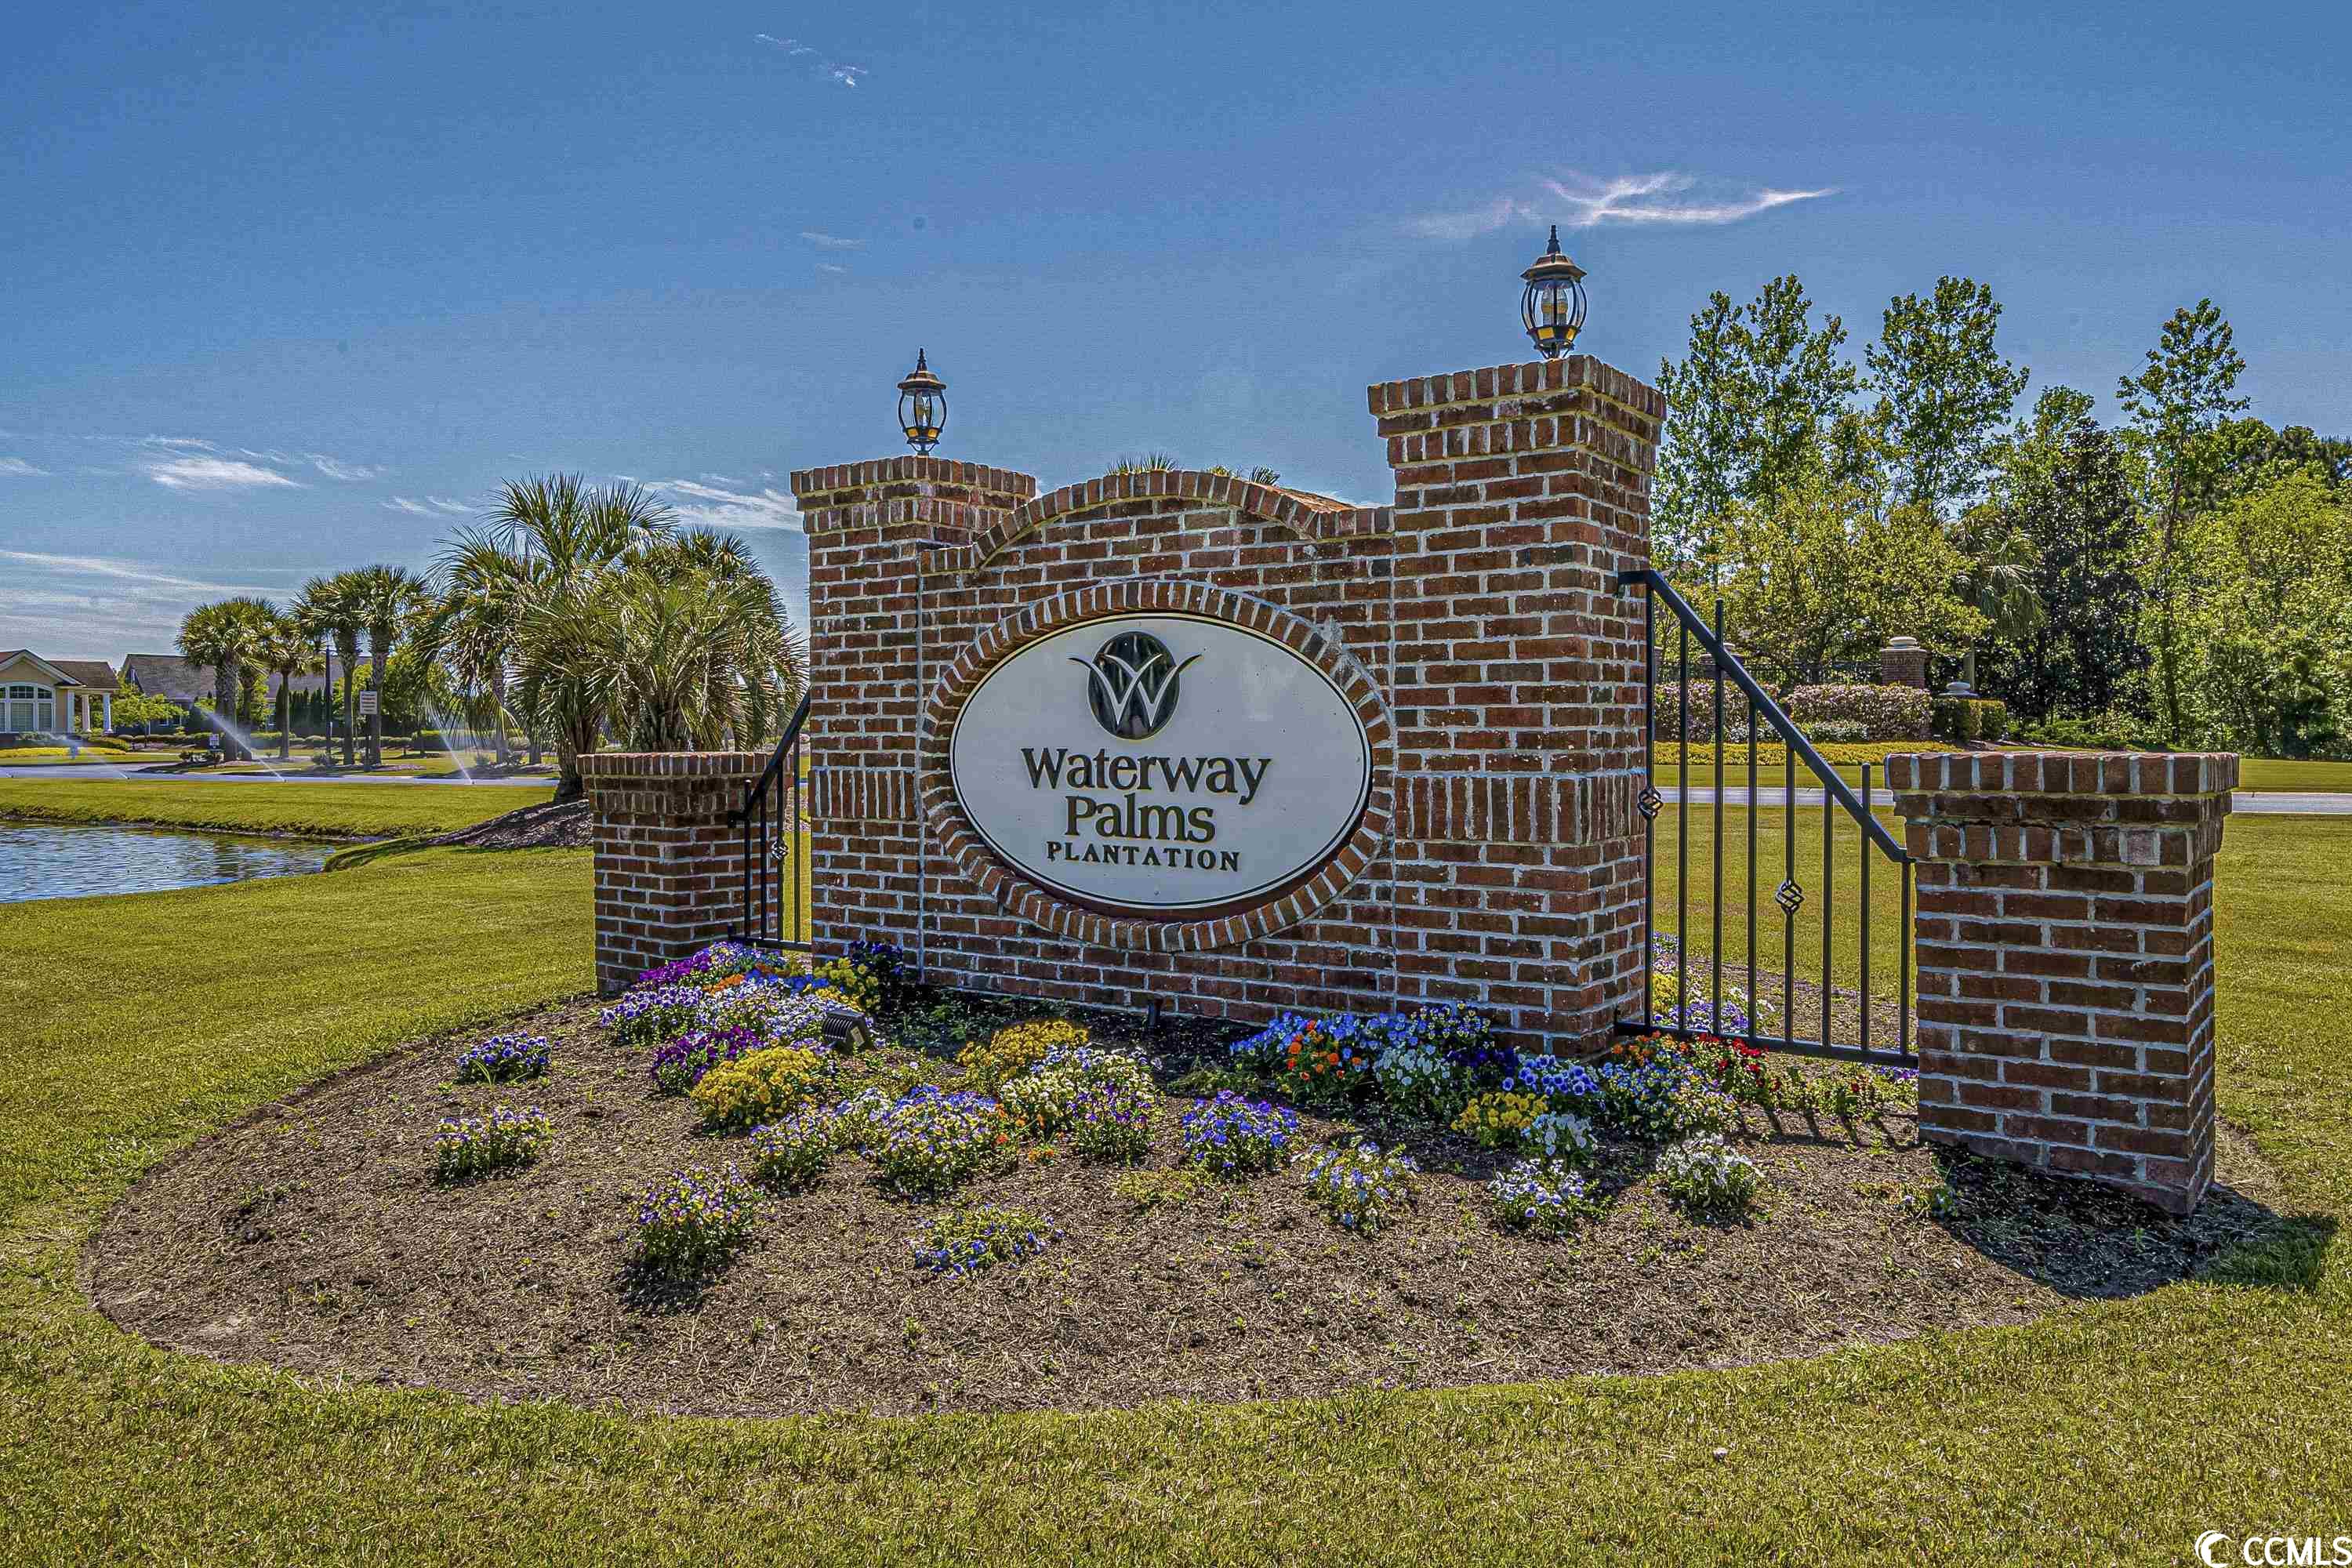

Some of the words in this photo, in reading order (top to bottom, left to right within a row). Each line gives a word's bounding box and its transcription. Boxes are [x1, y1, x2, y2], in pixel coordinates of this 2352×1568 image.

[1021, 748, 1272, 805] Waterway
[1064, 793, 1216, 843] Palms
[1047, 841, 1240, 872] PLANTATION
